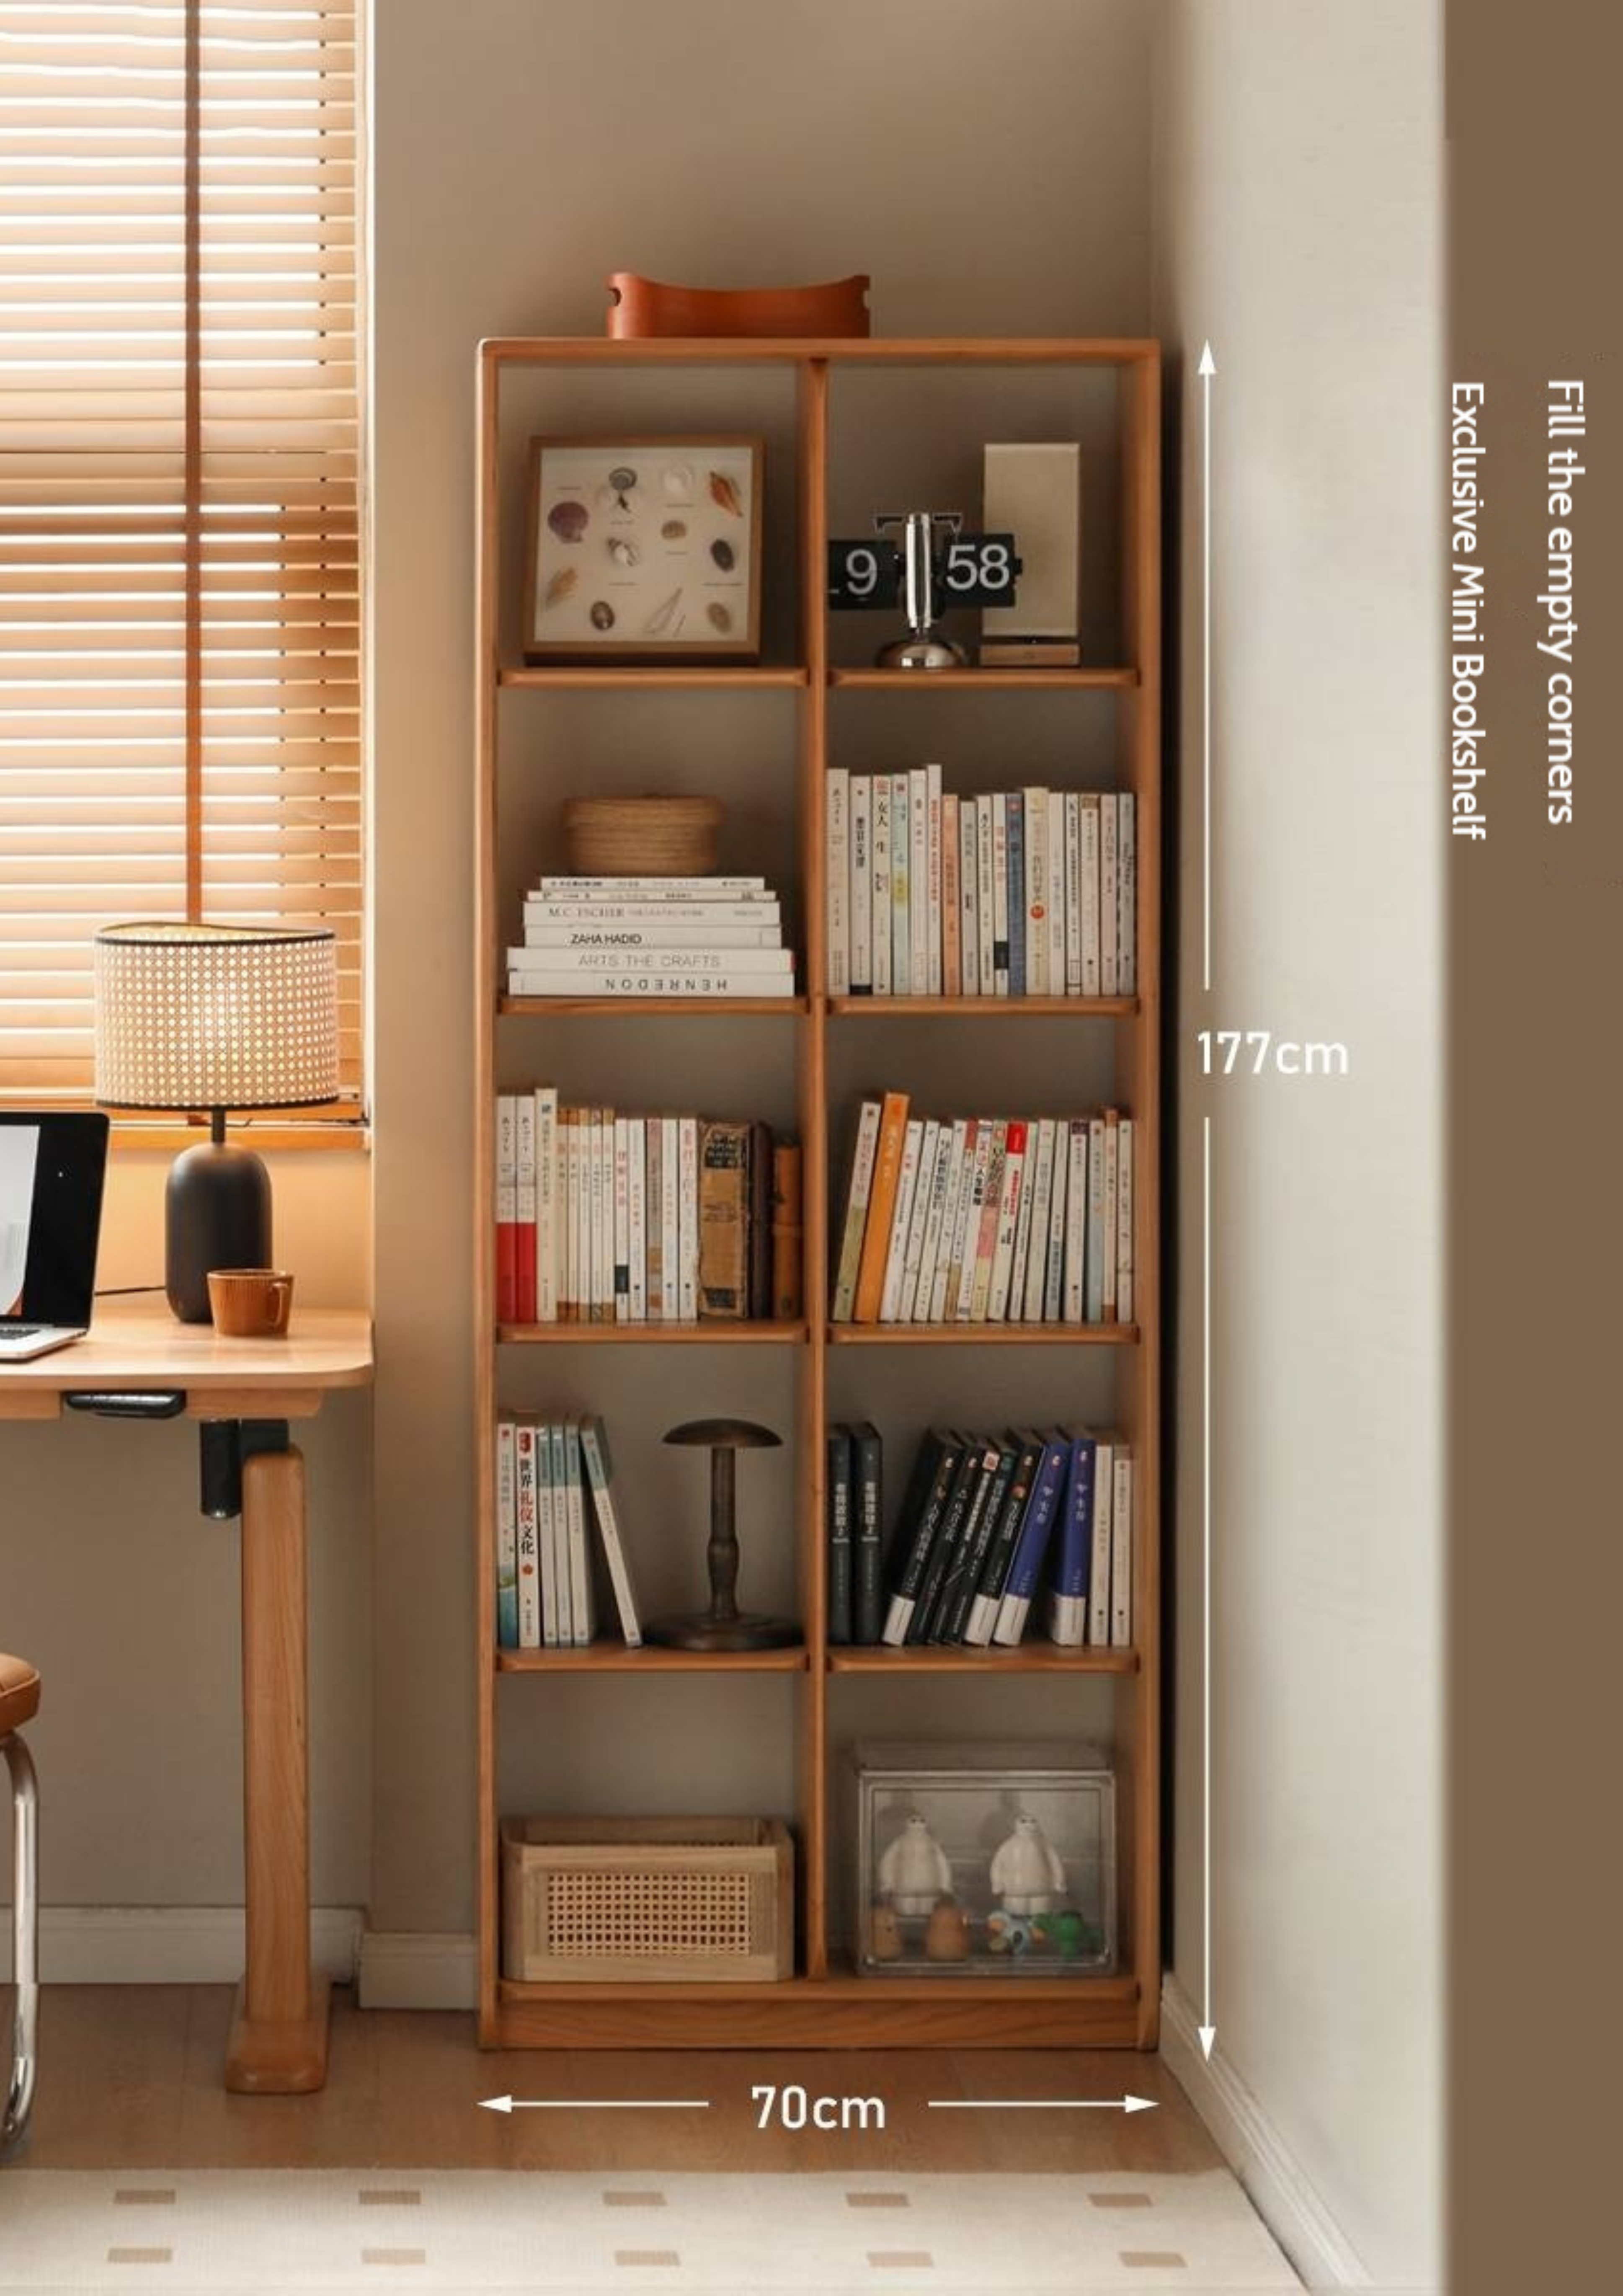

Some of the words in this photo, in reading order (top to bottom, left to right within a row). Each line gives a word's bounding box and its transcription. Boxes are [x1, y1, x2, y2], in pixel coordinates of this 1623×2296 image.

[846, 549, 878, 594] 9
[947, 544, 1010, 590] 58
[571, 933, 602, 944] ZAHA
[604, 933, 642, 944] HADID
[578, 954, 619, 967] ARTS
[627, 954, 653, 967] THE
[659, 954, 720, 967] CRAFTS
[605, 979, 728, 992] HENREDON
